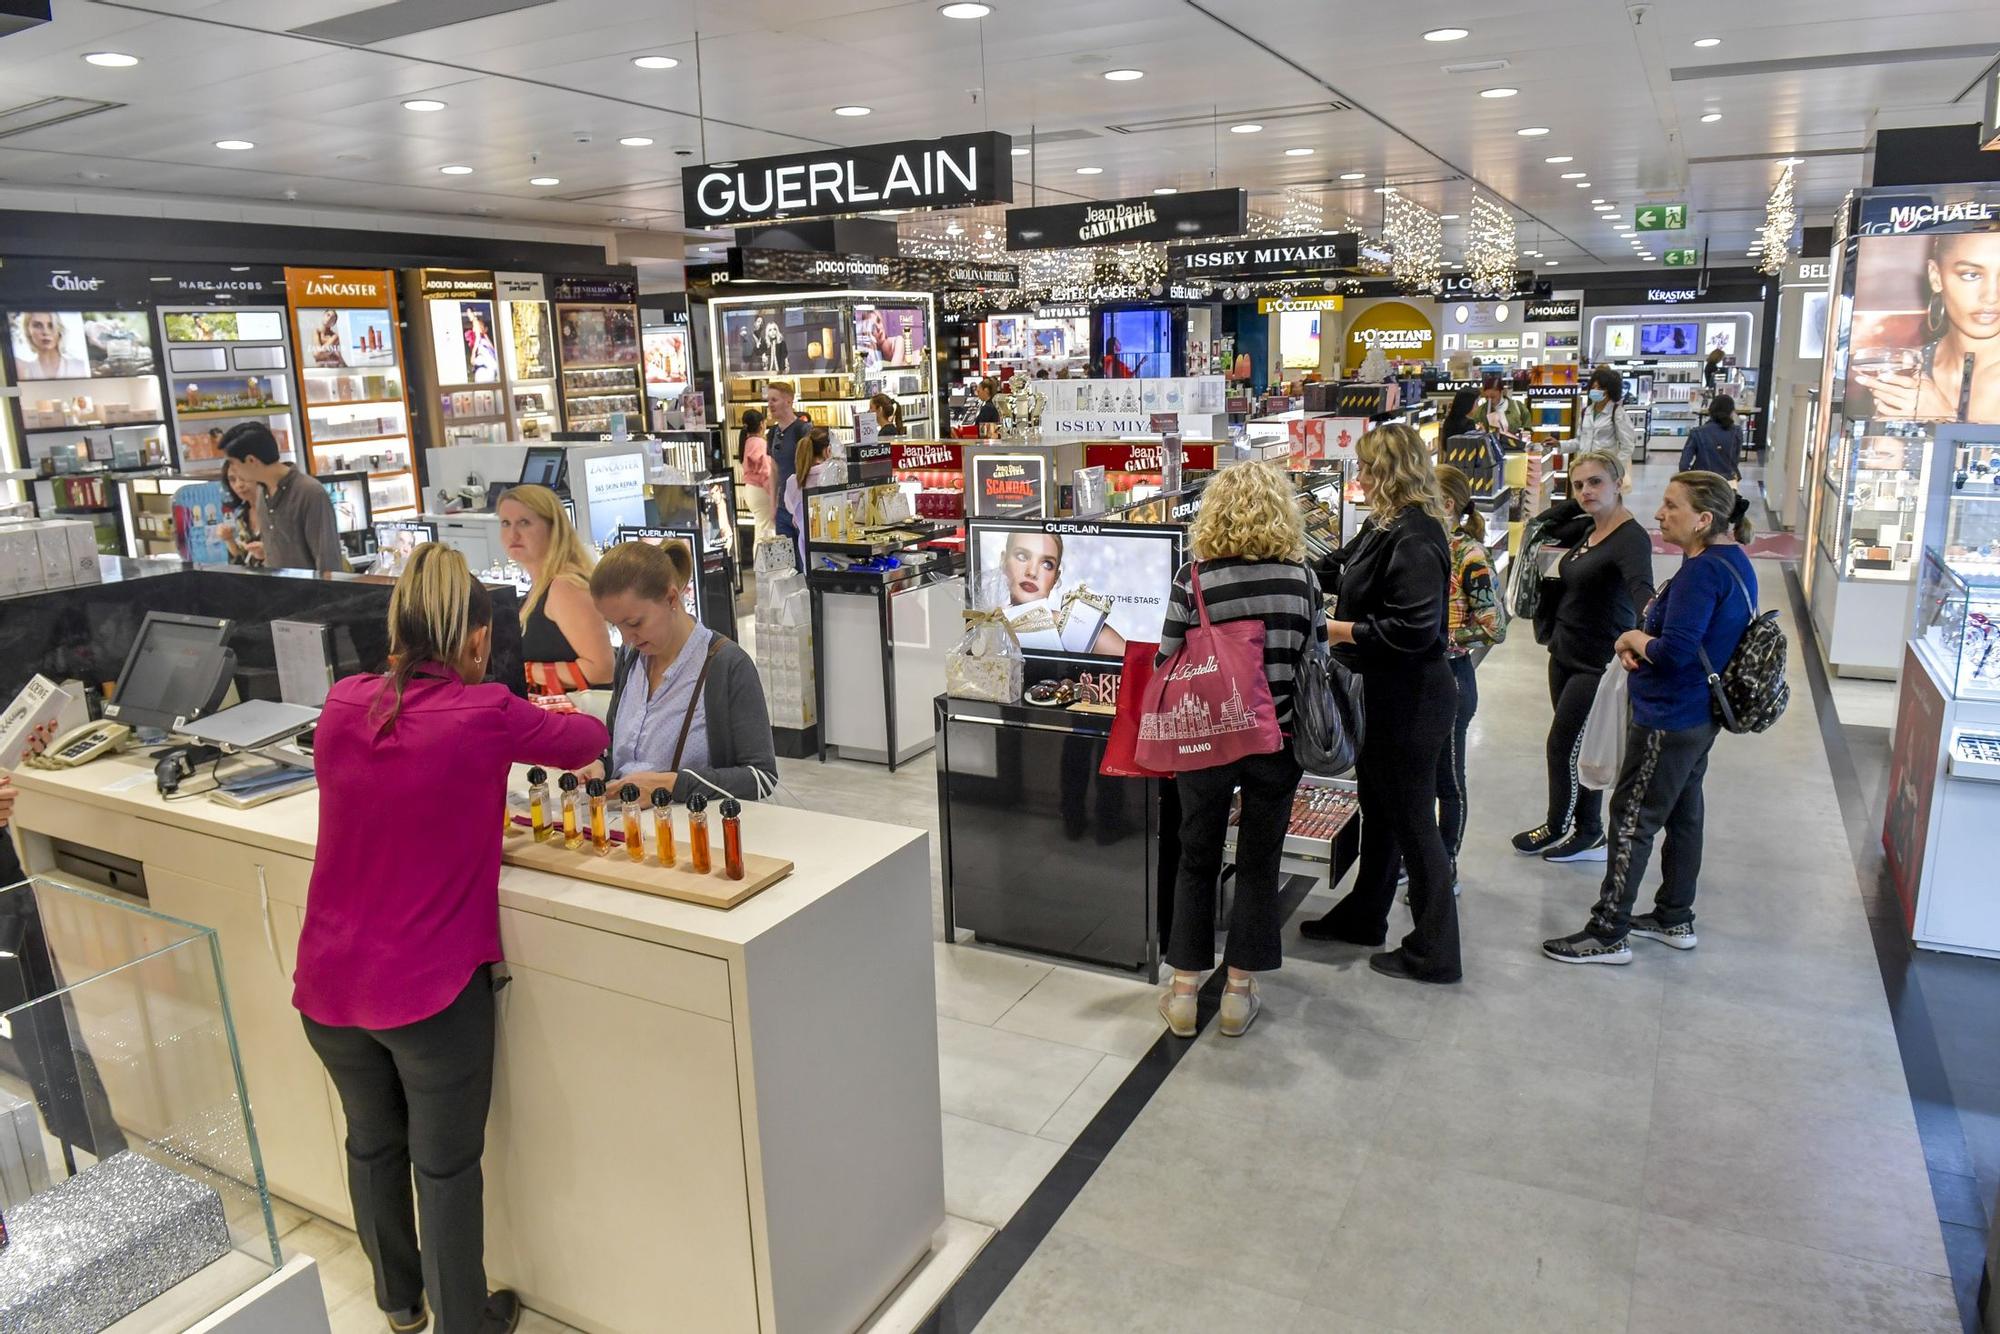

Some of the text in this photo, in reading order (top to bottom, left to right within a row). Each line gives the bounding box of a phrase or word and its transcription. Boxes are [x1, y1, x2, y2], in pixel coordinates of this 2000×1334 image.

[698, 147, 977, 216] GUERLAIN
[1085, 201, 1149, 224] Jean Paul
[1890, 202, 1991, 222] MICHAEL
[1079, 208, 1157, 241] GAULTIER
[1186, 245, 1336, 268] ISSEY MIYAKE
[816, 259, 889, 278] paco rabanne
[949, 268, 1015, 282] CAROLINA HERRERA
[52, 275, 98, 291] Chloé
[179, 281, 262, 290] MARC JACOBS
[306, 281, 376, 296] LANCASTER
[1648, 289, 1696, 300] KÉRASTASE
[1266, 299, 1335, 312] L'OCCITANE
[1528, 305, 1577, 317] AMOUAGE
[1354, 328, 1433, 343] L'OCCITANE
[1056, 420, 1106, 433] ISSEY
[860, 447, 891, 460] GUERLAIN
[902, 444, 946, 458] Jean Paul
[1130, 445, 1155, 458] Jean
[898, 450, 953, 469] GAULTIER
[986, 479, 1034, 496] SCANDAL
[639, 529, 676, 538] GUERLAIN
[1045, 523, 1099, 535] GUERLAIN
[1179, 742, 1212, 755] MILANO
